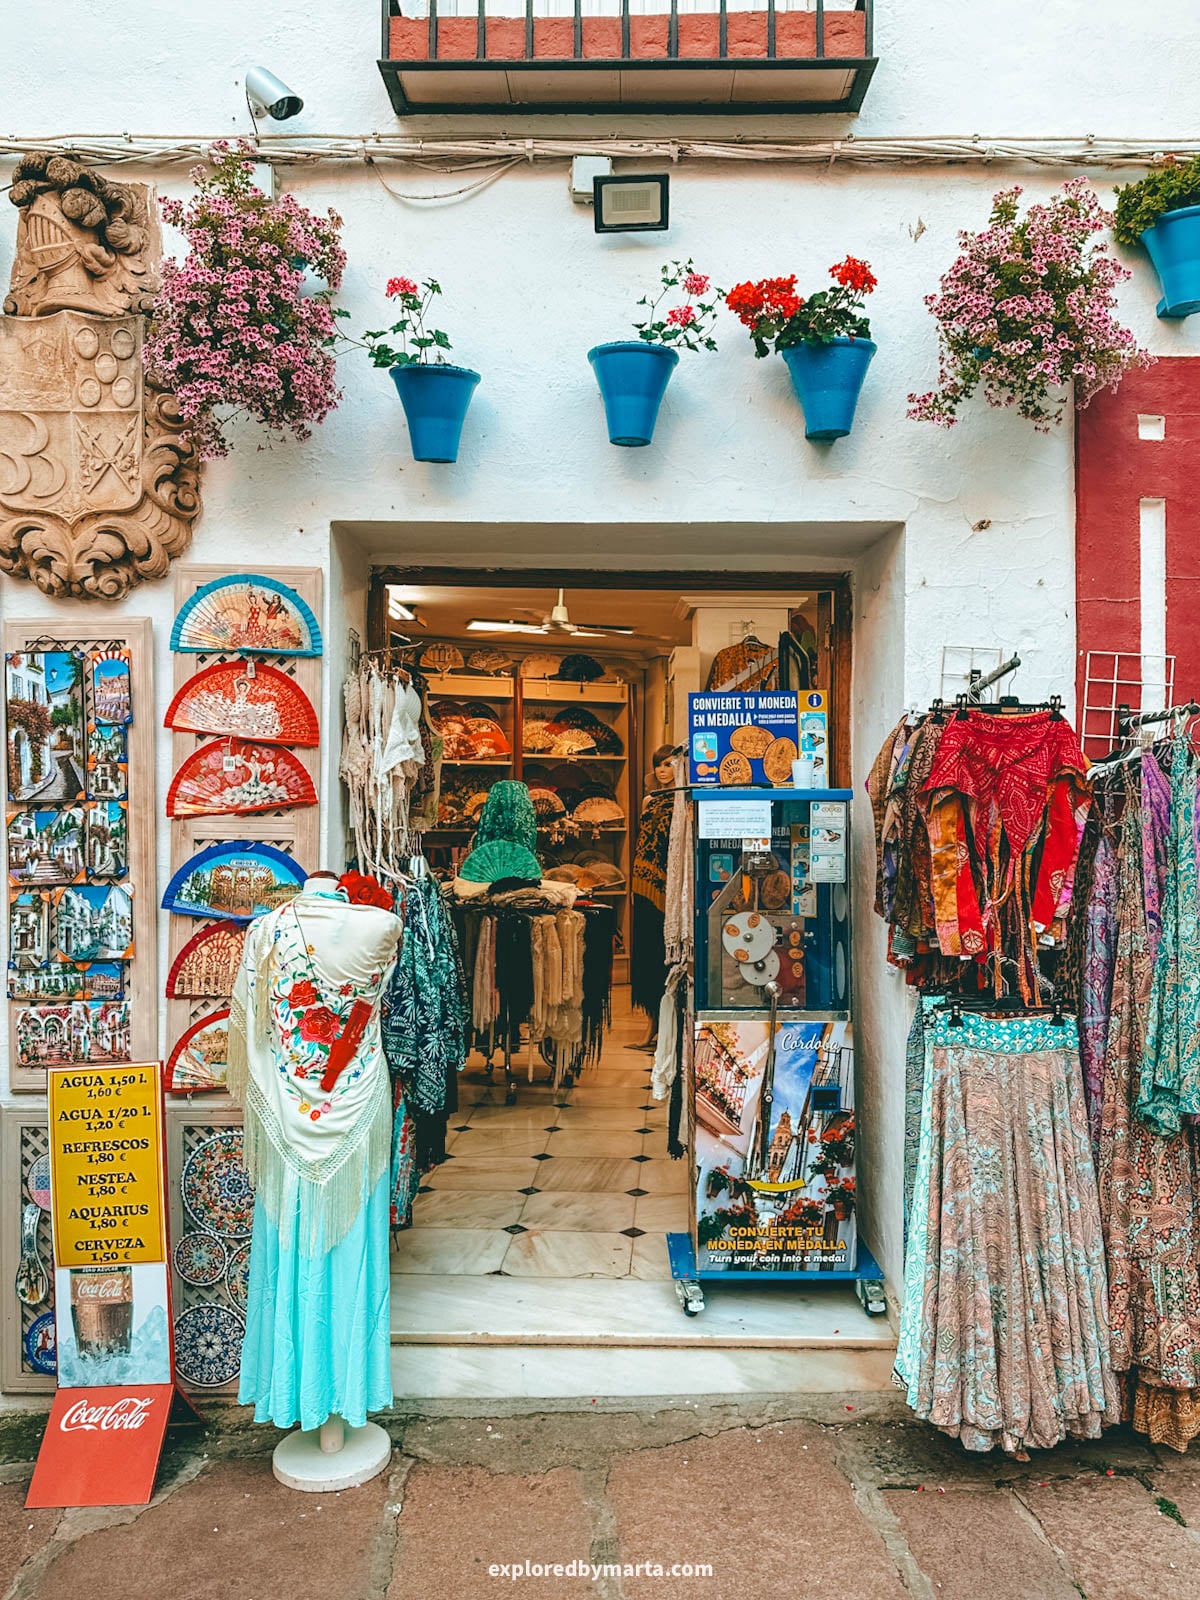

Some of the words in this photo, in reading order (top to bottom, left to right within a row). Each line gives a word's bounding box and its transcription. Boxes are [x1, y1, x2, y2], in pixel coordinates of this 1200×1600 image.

[693, 698, 741, 710] CONVIERTE
[744, 698, 755, 709] TU
[758, 697, 797, 709] MONEDA
[693, 715, 705, 727] EN
[707, 713, 752, 726] MEDALLA
[772, 826, 790, 836] NEDA
[709, 840, 719, 849] EN
[720, 839, 742, 848] MEDA
[60, 1076, 104, 1088] AGUA
[109, 1075, 135, 1087] 1,50
[87, 1088, 111, 1098] 1,60
[115, 1087, 121, 1096] €
[58, 1108, 103, 1121] AGUA
[107, 1107, 138, 1120] 1/20
[85, 1119, 113, 1131] 1,20
[118, 1120, 125, 1128] €
[63, 1139, 149, 1154] REFRESCOS
[87, 1153, 114, 1164] 1,80
[119, 1153, 126, 1161] €
[77, 1172, 137, 1185] NESTEA
[88, 1186, 115, 1197] 1,80
[121, 1186, 127, 1194] €
[68, 1204, 149, 1220] AQUARIUS
[89, 1218, 117, 1229] 1,80
[122, 1218, 128, 1227] €
[729, 1227, 803, 1237] CONVIERTE
[806, 1226, 824, 1236] TU
[74, 1238, 145, 1251] CERVEZA
[707, 1240, 761, 1250] MONEDA
[766, 1240, 783, 1250] EN
[786, 1239, 846, 1250] MEDALLA
[91, 1252, 119, 1262] 1,50
[124, 1252, 131, 1260] €
[709, 1254, 732, 1263] Turn
[734, 1255, 757, 1265] your
[759, 1254, 780, 1263] coin
[783, 1254, 801, 1263] into
[803, 1255, 811, 1263] a
[813, 1253, 845, 1263] medal
